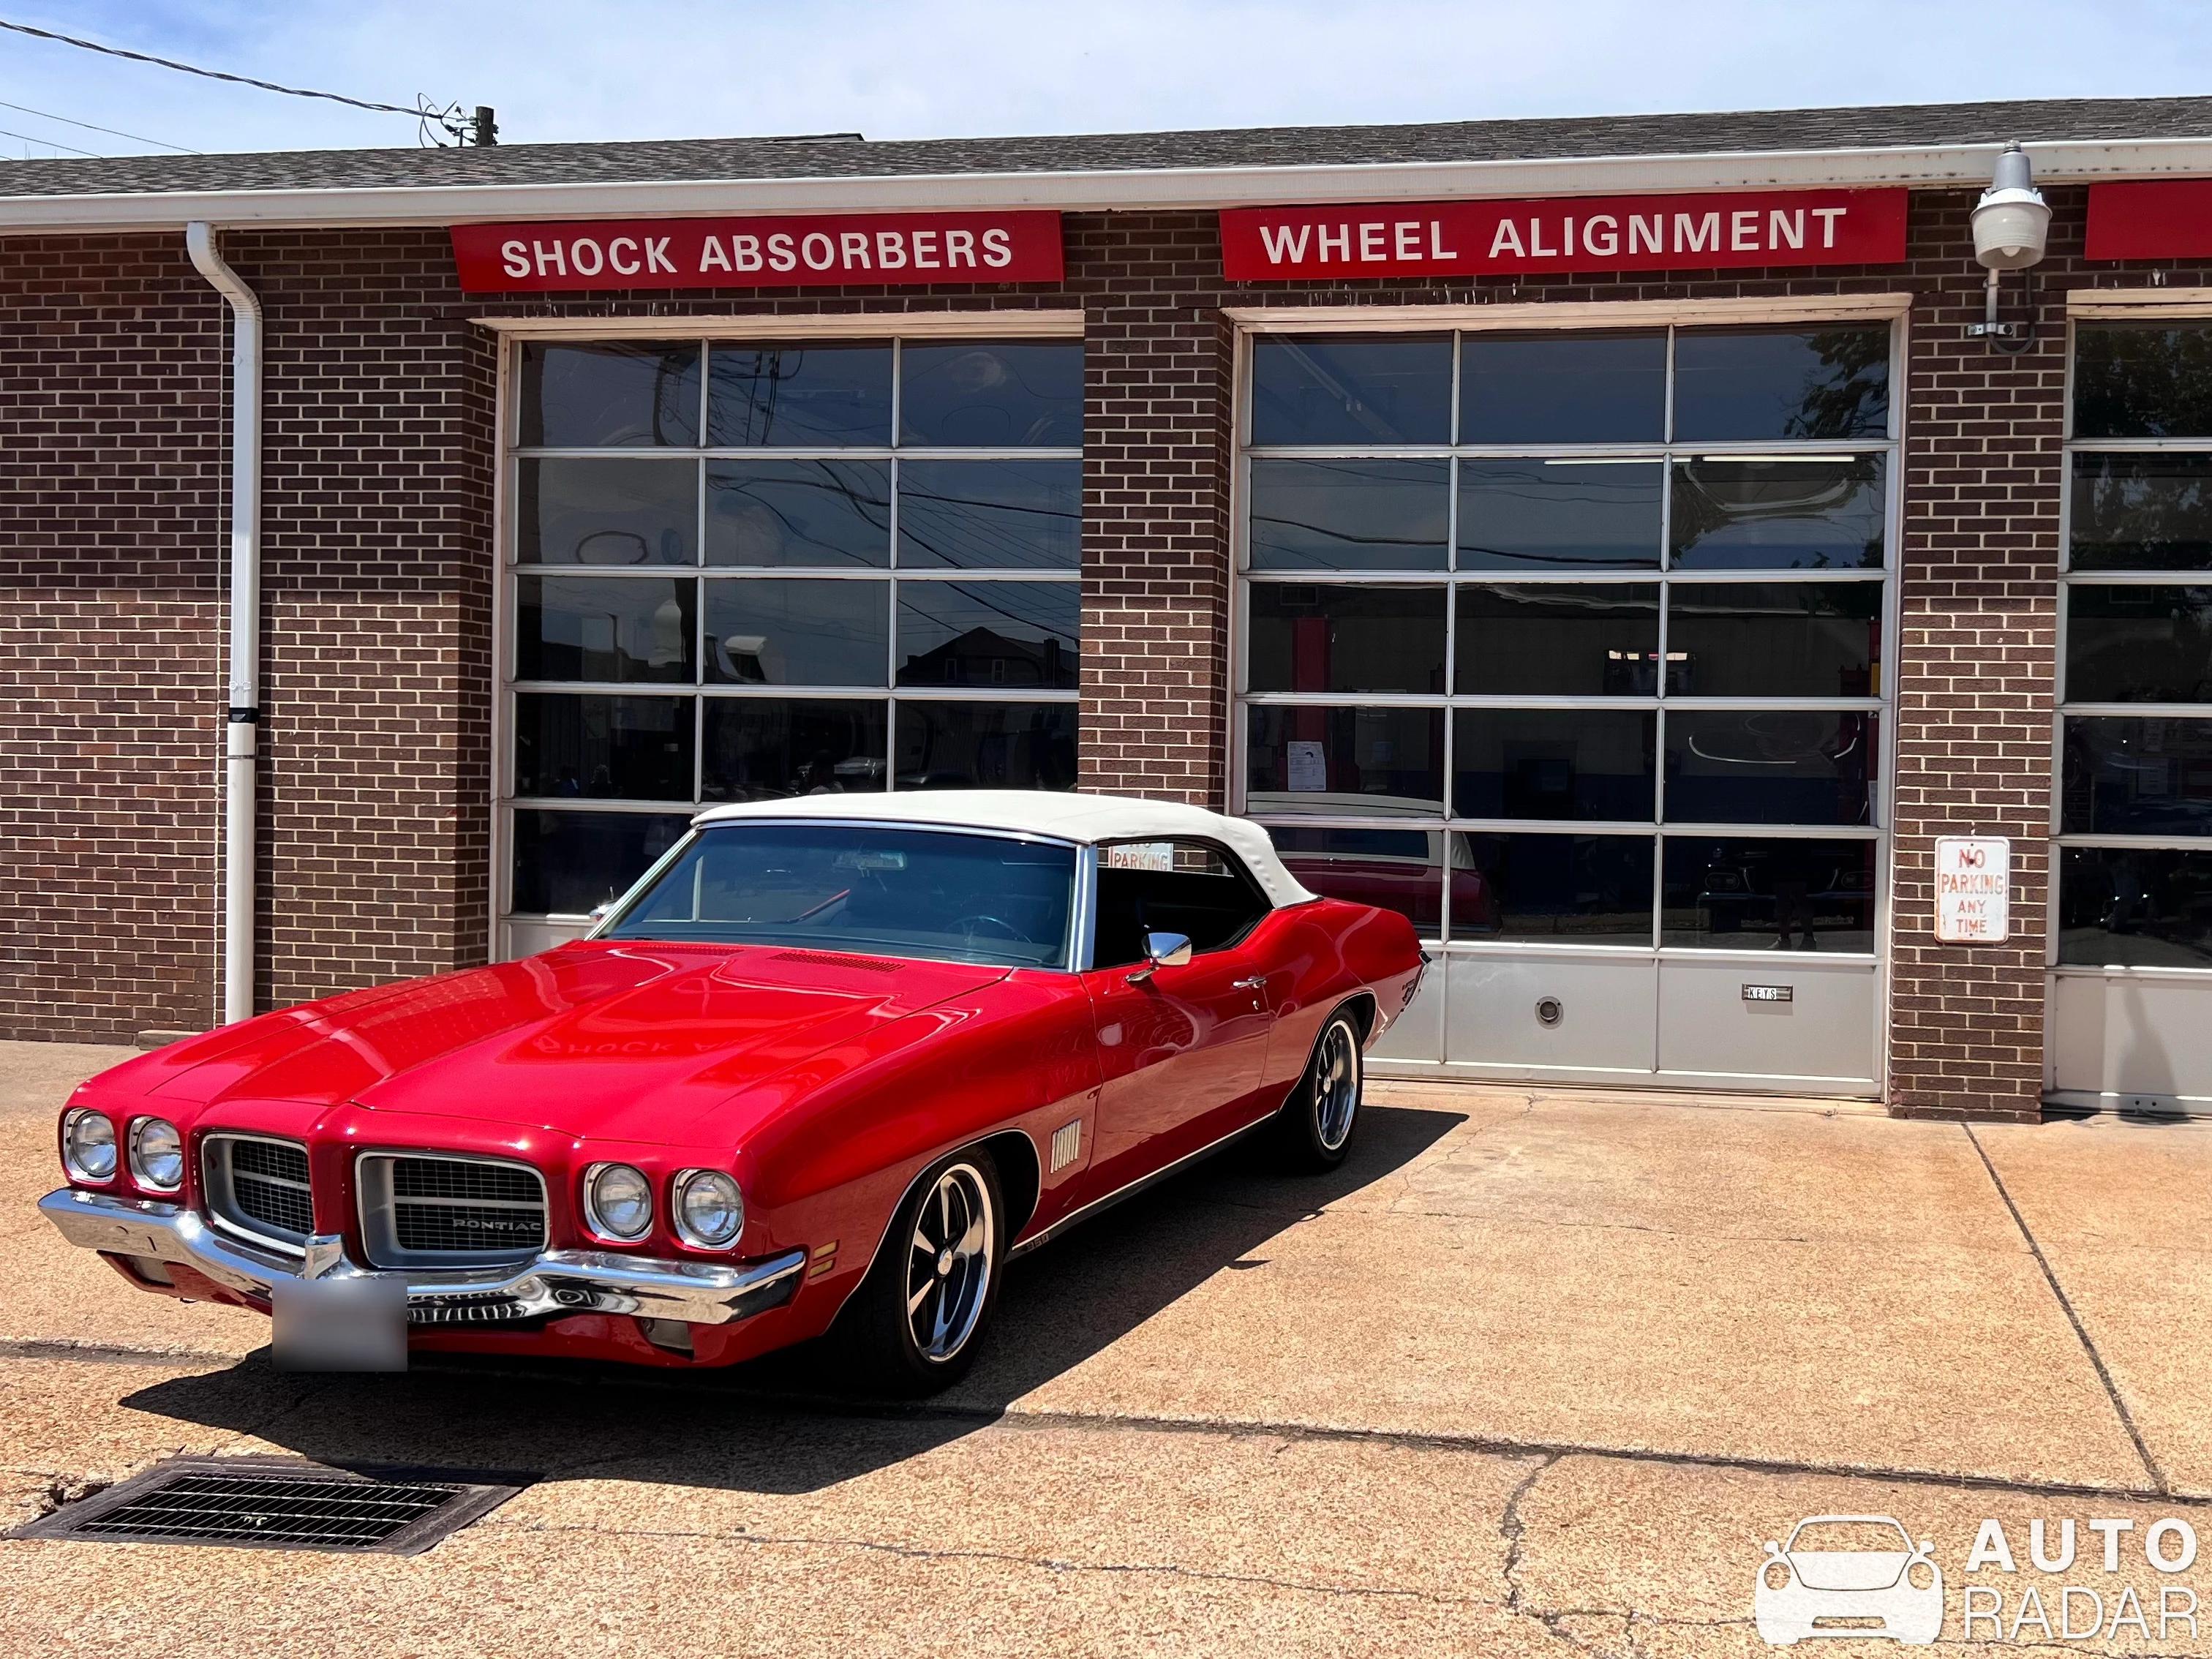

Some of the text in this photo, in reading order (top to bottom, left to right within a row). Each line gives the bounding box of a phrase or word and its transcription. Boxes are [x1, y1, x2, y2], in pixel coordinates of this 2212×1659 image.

[1259, 208, 1847, 264] WHEEL ALIGNMENT
[501, 228, 1012, 278] SHOCK ABSORBERS
[1113, 851, 1169, 871] PARKING
[1958, 849, 1986, 868] NO
[1941, 873, 2004, 895] PARKING
[1957, 899, 1987, 914] ANY
[1955, 919, 1987, 933] TIME
[1749, 988, 1776, 1000] KEYS
[452, 1218, 542, 1230] PONTIAC
